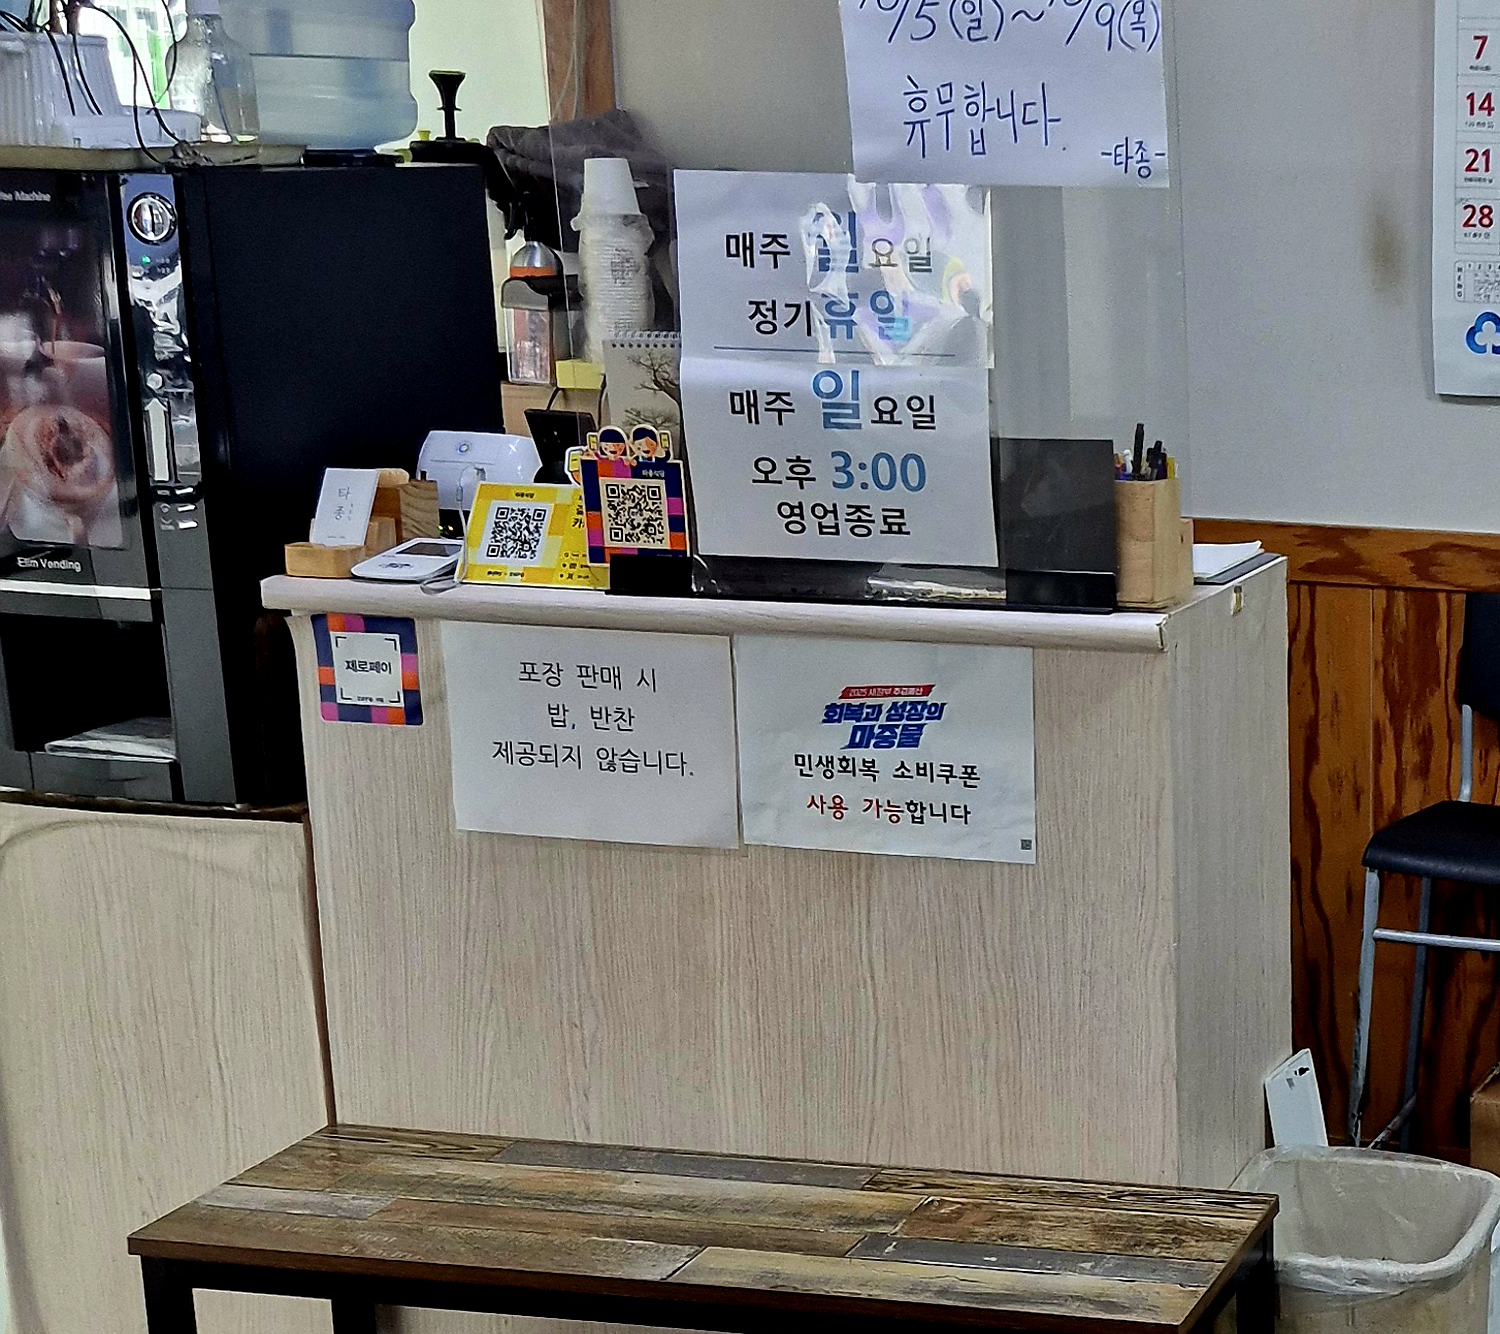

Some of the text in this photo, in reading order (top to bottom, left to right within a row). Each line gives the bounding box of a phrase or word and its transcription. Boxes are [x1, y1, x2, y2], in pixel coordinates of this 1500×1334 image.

[1473, 35, 1489, 61] 7
[903, 74, 1067, 159] 휴무합니다.
[1465, 91, 1496, 117] 14
[1464, 147, 1491, 174] 21
[1461, 203, 1494, 229] 28
[725, 232, 791, 269] 매주
[748, 290, 911, 341] 정기휴일
[729, 369, 937, 430] 매주 일요일
[751, 450, 927, 492] 오후 3:00
[776, 500, 911, 538] 영업종료
[39, 558, 81, 572] Vending
[345, 659, 392, 675] 제로페이
[519, 661, 658, 693] 포장 판매 시
[547, 703, 636, 732] 밥, 반찬
[821, 700, 948, 724] 회복과 성장의
[842, 723, 927, 750] 마중물
[492, 740, 695, 777] 제공되지 않습니다.
[794, 753, 981, 789] 민생회복 소비쿠폰
[806, 794, 972, 825] 사용 가능합니다
